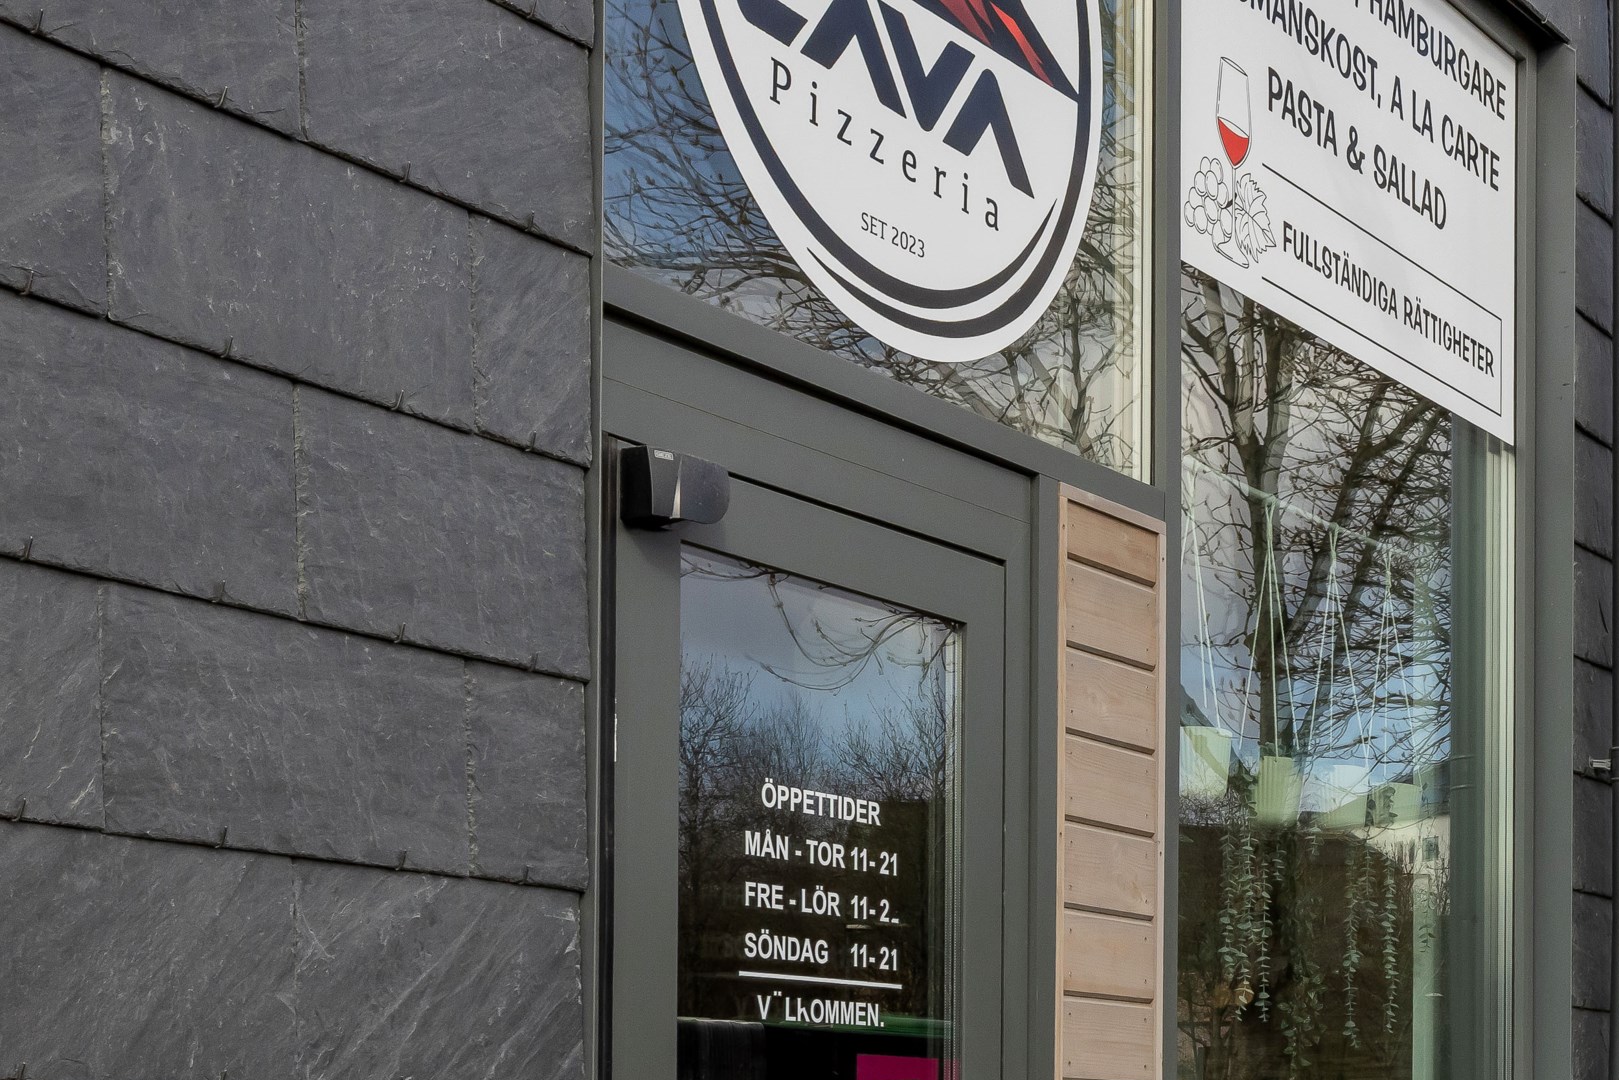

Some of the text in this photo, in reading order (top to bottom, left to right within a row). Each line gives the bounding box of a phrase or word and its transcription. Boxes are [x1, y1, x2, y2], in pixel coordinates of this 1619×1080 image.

[1240, 0, 1500, 192] ANSKOST, A LA CARTE
[769, 57, 1000, 232] Pizzeria
[1268, 66, 1447, 230] PASTA & SALLAD
[861, 212, 925, 258] SET 2023
[1283, 220, 1495, 377] FULLSTÄNDIGA RÄTTIGHETER
[761, 777, 881, 826] ÖPPETTIDER
[745, 829, 789, 860] MÅN
[806, 839, 846, 869] TOR
[745, 881, 784, 910] FRE
[801, 885, 841, 917] LÖR
[851, 895, 899, 924] 11-2
[744, 928, 829, 964] SÖNDAG
[757, 991, 885, 1027] VLKOMMEN.
